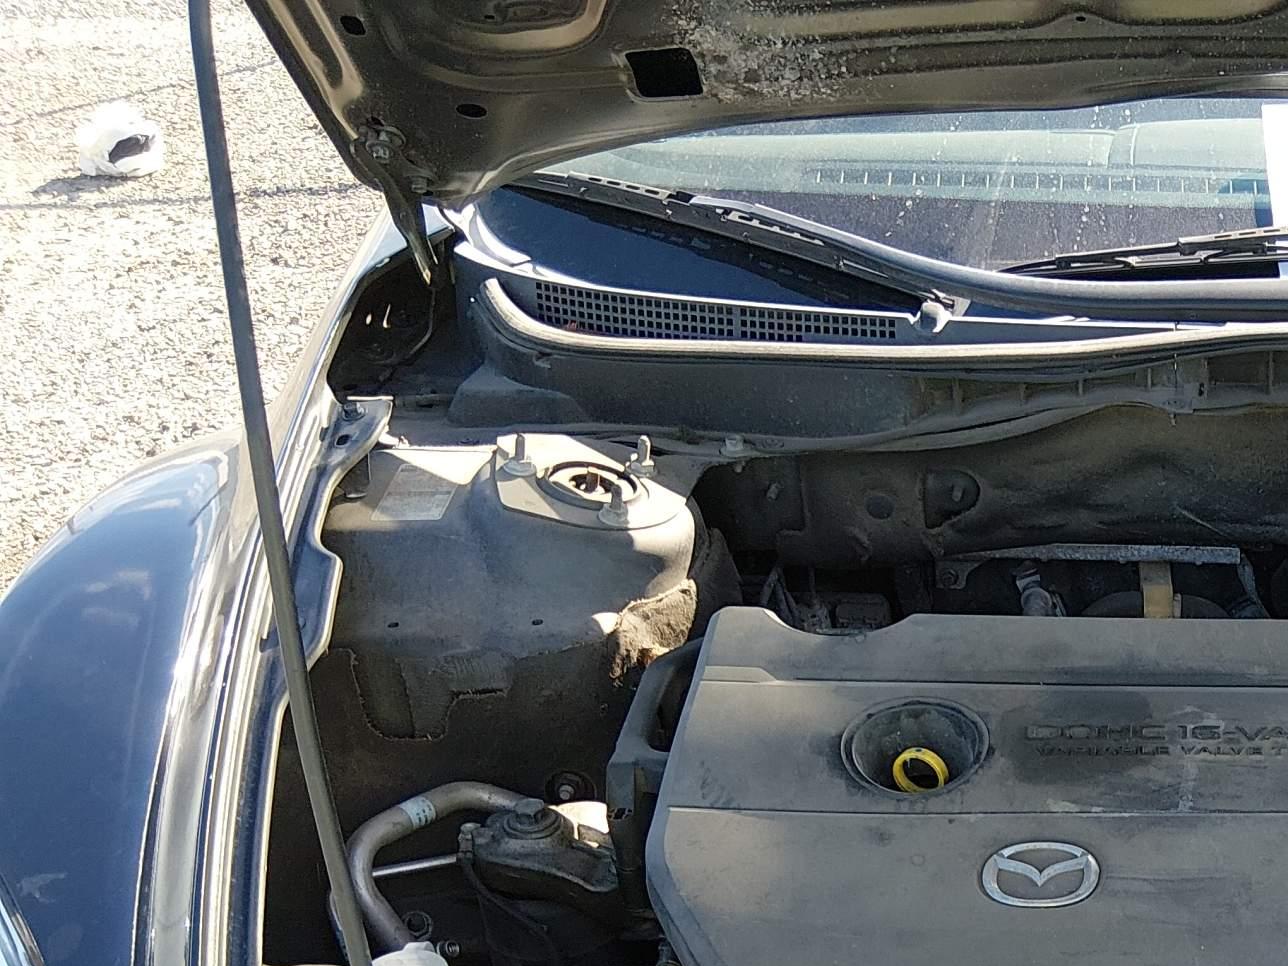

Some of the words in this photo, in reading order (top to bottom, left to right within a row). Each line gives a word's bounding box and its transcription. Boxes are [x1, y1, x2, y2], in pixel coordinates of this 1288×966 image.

[1024, 724, 1167, 741] DOHC
[1036, 745, 1171, 757] VARIABLE
[1180, 745, 1264, 757] VALVE
